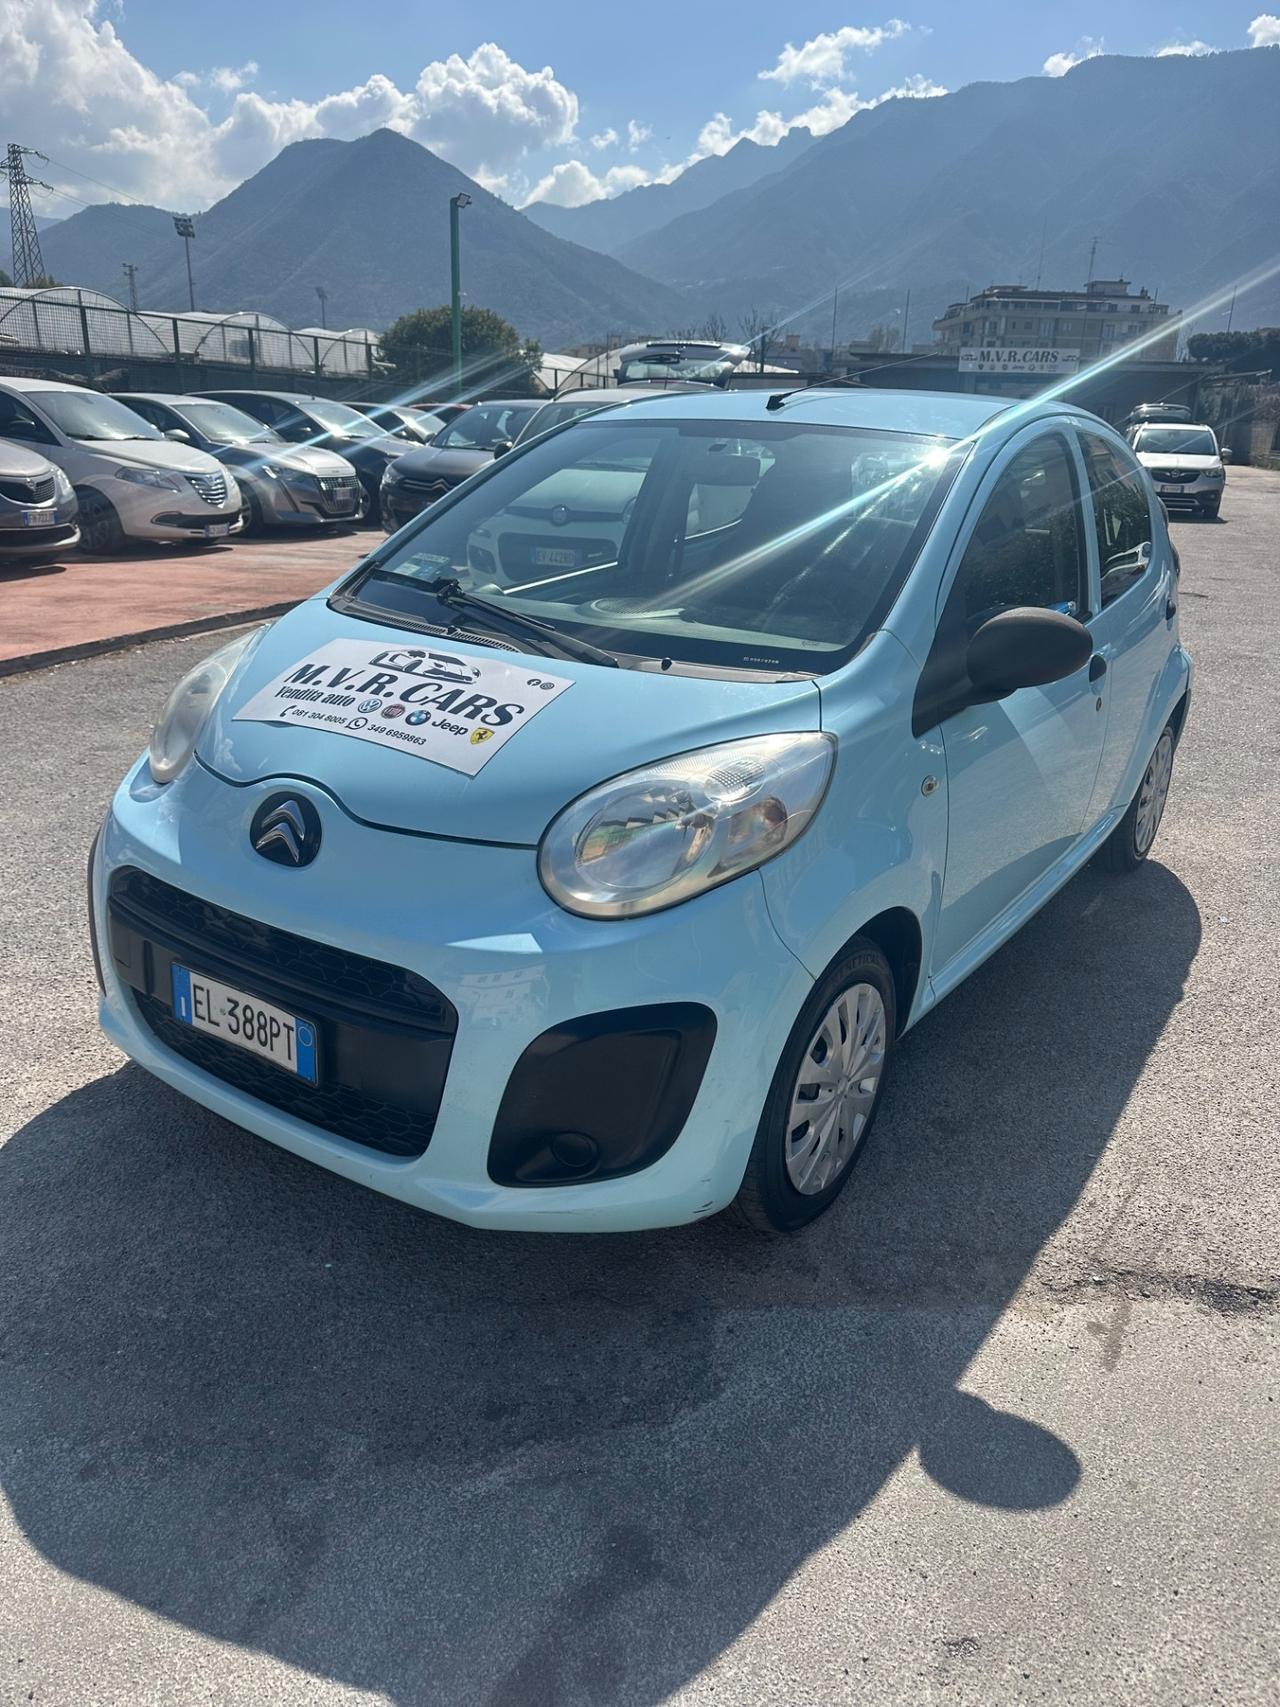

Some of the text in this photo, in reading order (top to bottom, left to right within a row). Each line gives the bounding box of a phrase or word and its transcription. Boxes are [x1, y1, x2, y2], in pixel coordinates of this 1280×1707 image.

[274, 685, 357, 707] Vendita auto
[291, 708, 349, 725] 081 304 8005
[367, 723, 427, 746] 349 6959863
[431, 718, 469, 736] Jeep
